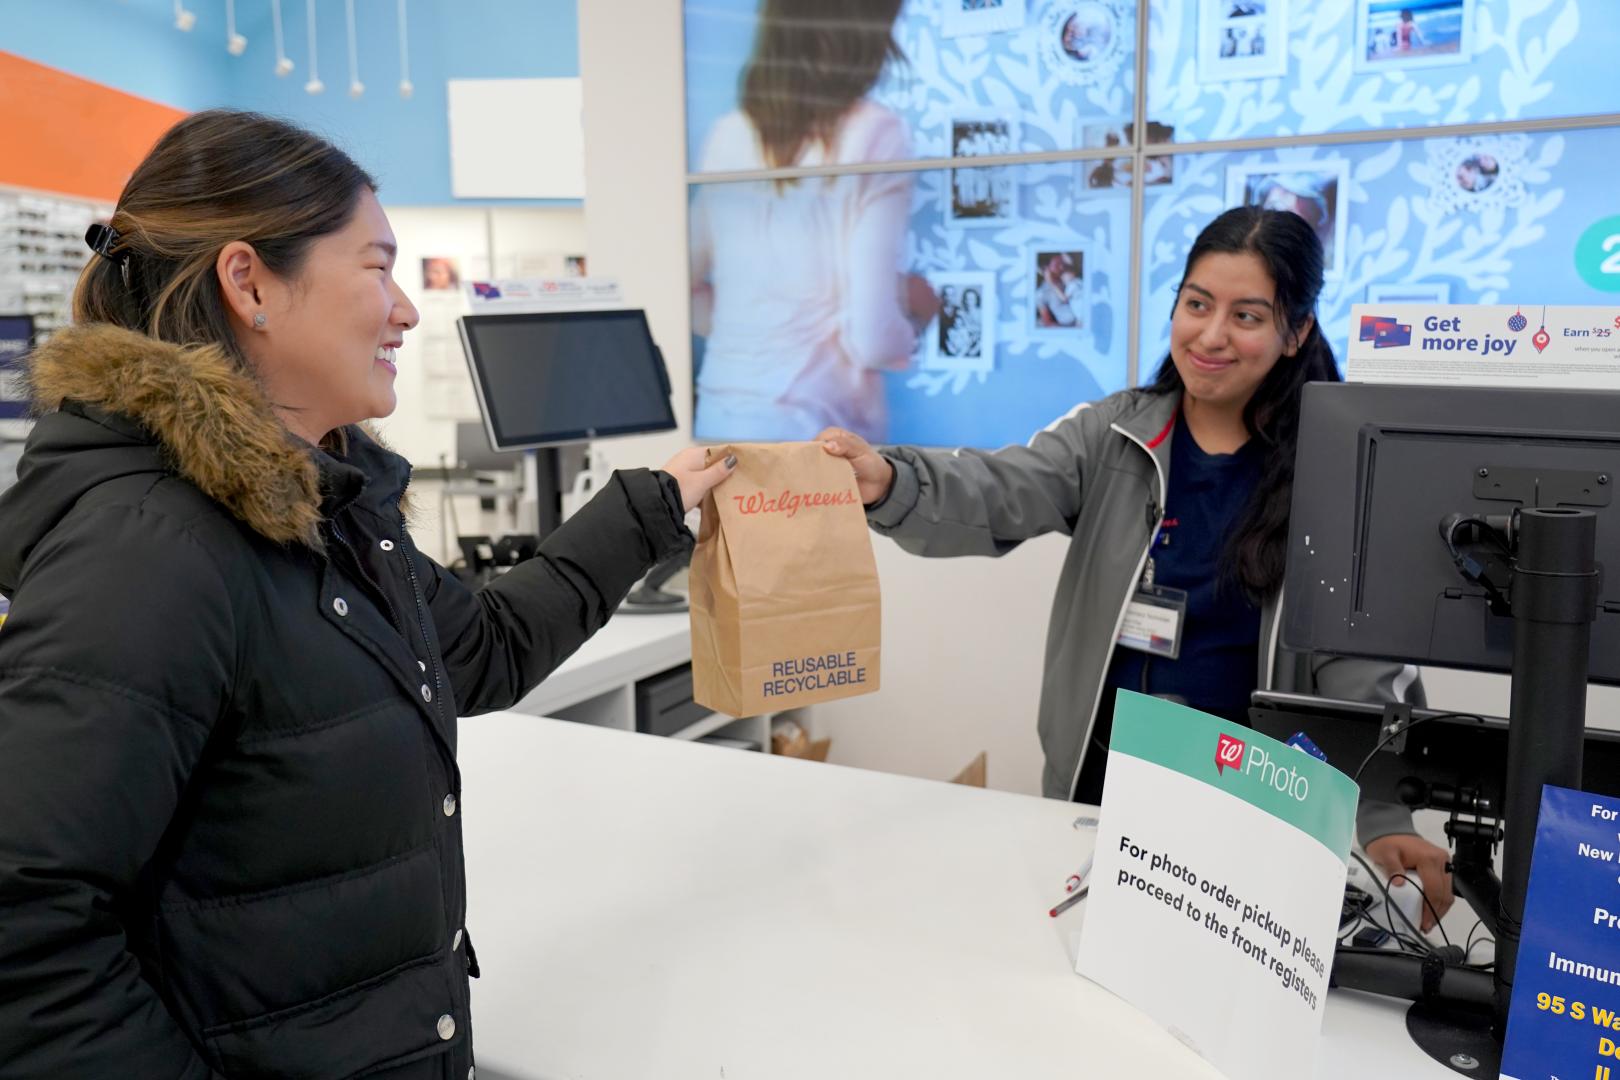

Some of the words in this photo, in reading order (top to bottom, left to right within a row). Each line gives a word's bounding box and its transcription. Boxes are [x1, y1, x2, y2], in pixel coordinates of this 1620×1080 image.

[1424, 315, 1461, 332] Get
[1563, 327, 1589, 337] Earn
[1592, 327, 1611, 338] $25
[1422, 338, 1479, 351] more
[1481, 334, 1517, 356] joy
[732, 488, 857, 518] Walgreens
[772, 651, 856, 677] REUSABLE
[763, 668, 866, 697] RECYCLABLE
[1246, 745, 1309, 801] Photo
[1591, 804, 1618, 821] For
[1578, 842, 1614, 862] New
[1119, 836, 1148, 860] For
[1150, 853, 1197, 886] photo
[1200, 880, 1241, 911] order
[1242, 904, 1291, 948] pickup
[1292, 937, 1325, 978] please
[1117, 869, 1184, 911] proceed
[1186, 901, 1201, 921] to
[1205, 911, 1228, 939] the
[1231, 926, 1267, 965] front
[1269, 956, 1317, 1011] registers
[1548, 952, 1620, 986] Immun
[1536, 992, 1565, 1015] 95
[1569, 1001, 1586, 1021] S
